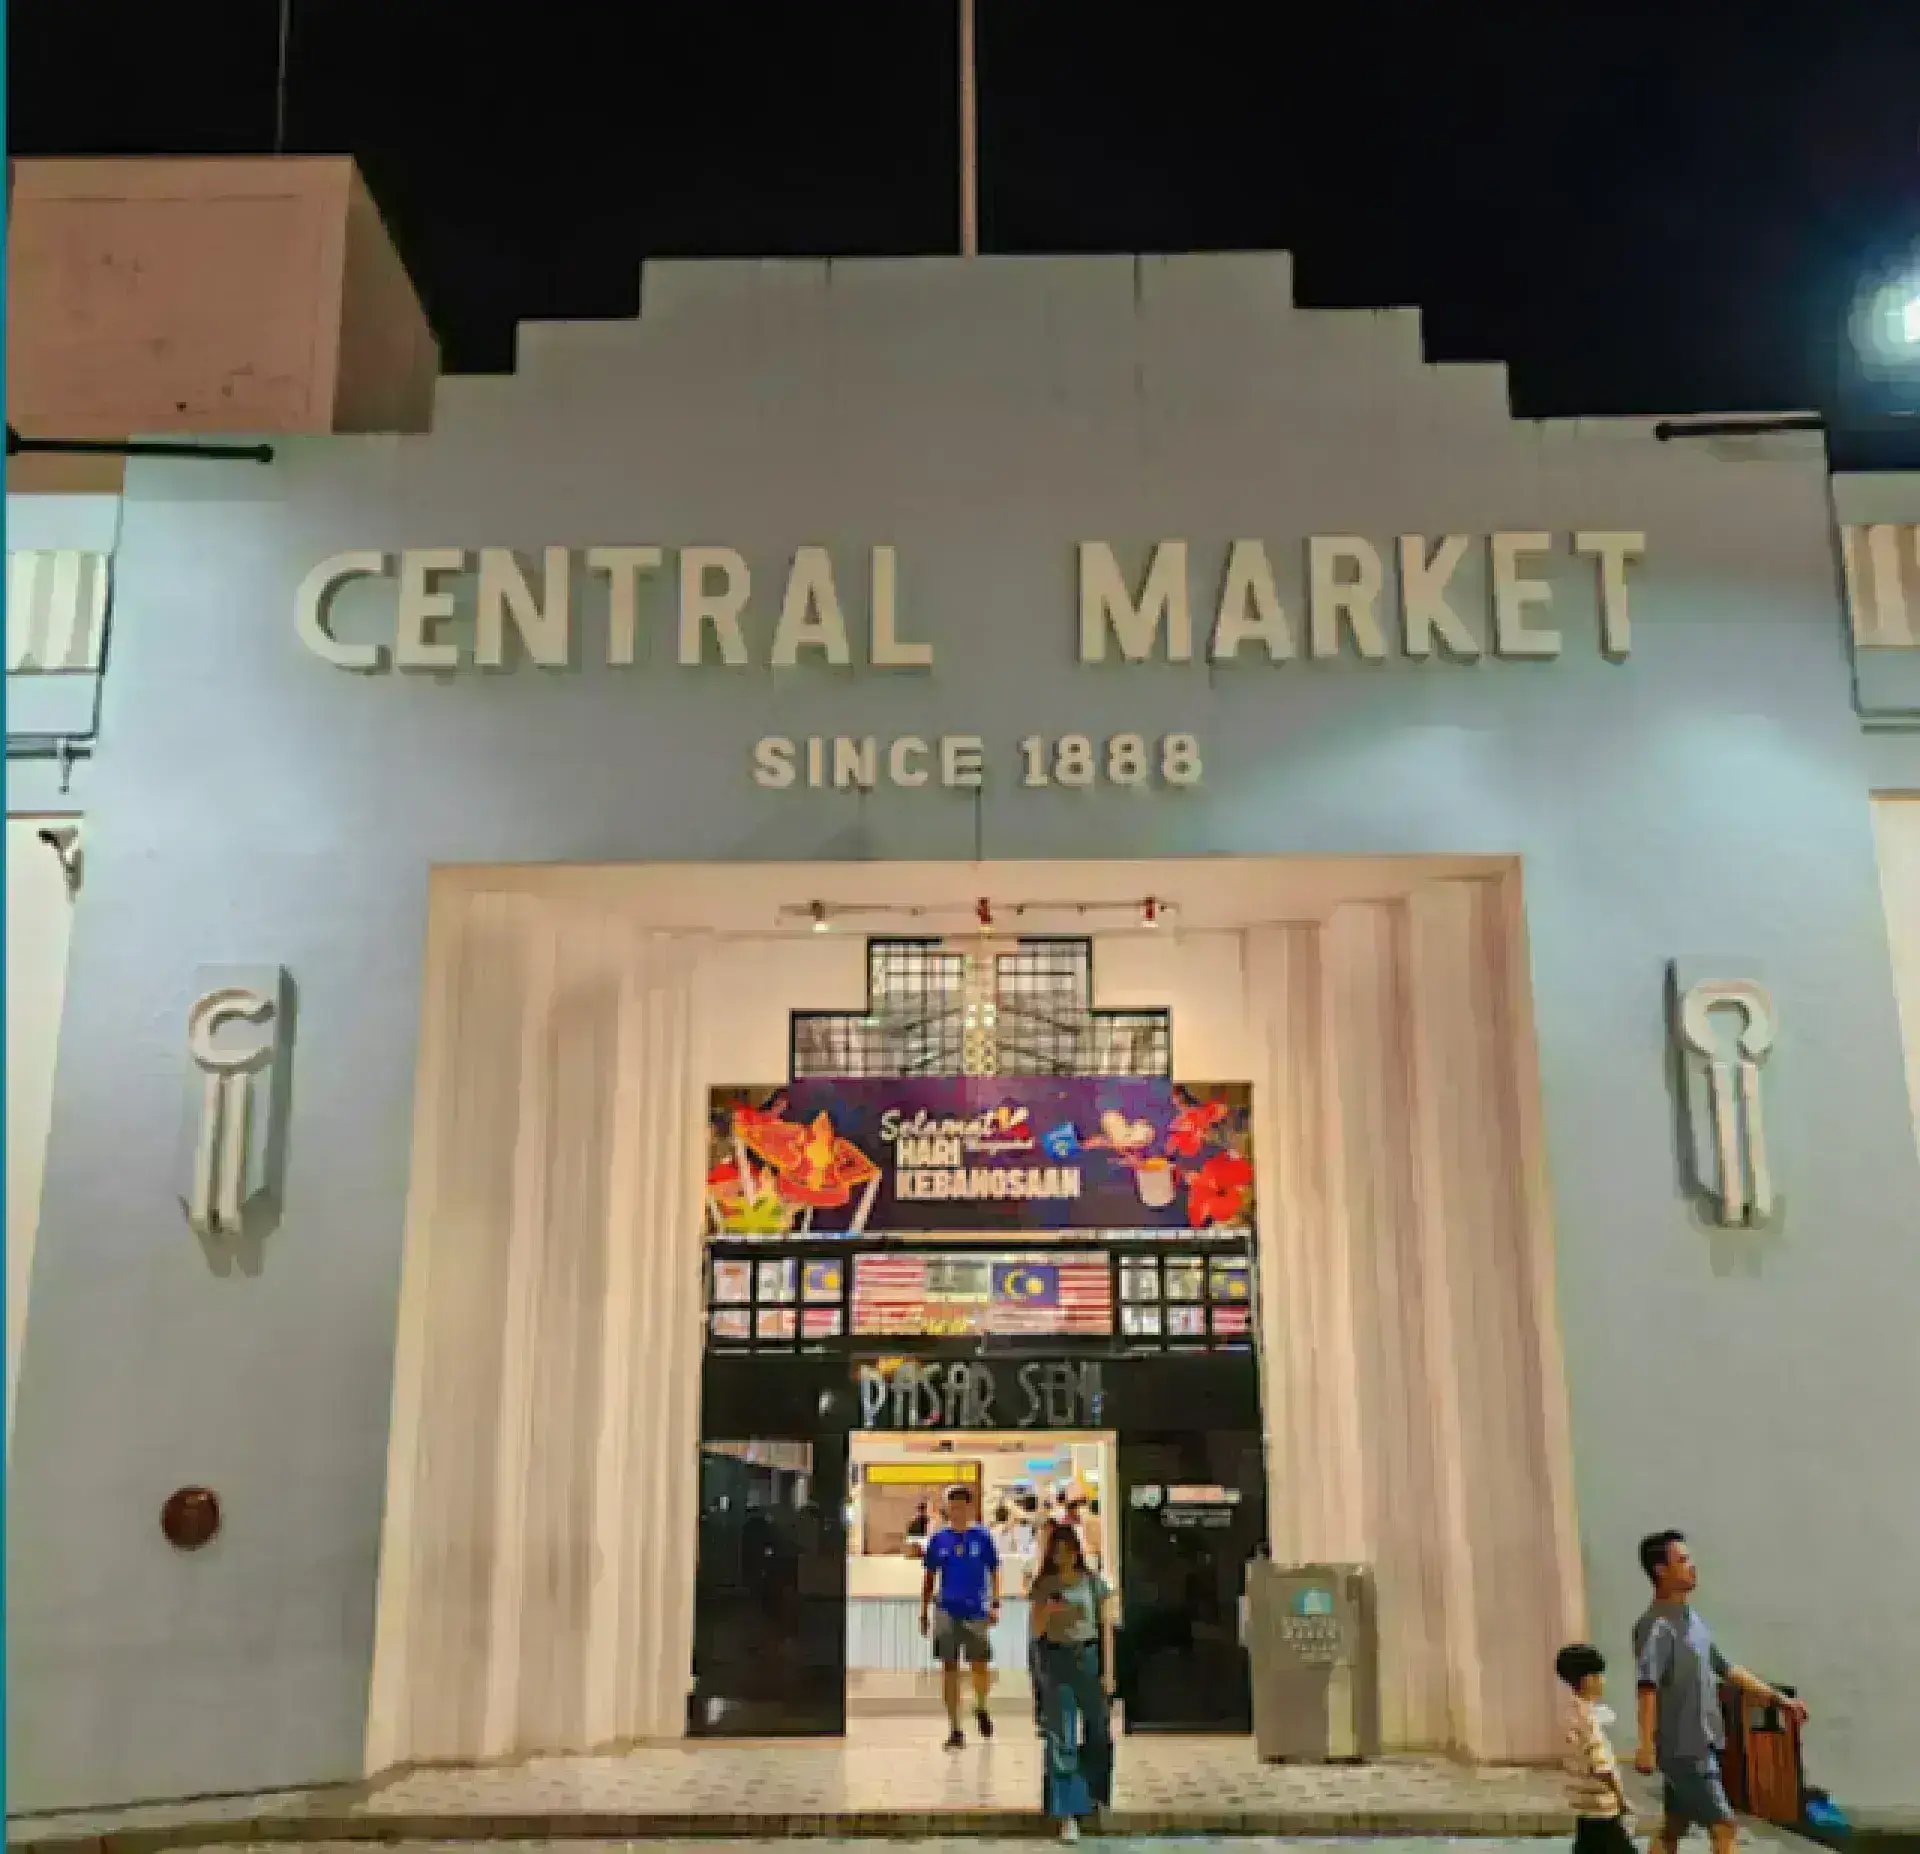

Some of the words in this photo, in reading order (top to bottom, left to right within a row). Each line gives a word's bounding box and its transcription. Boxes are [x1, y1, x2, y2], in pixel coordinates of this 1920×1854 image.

[295, 545, 932, 669] CENTRAL
[1077, 531, 1645, 663] MARKET
[754, 735, 983, 787] SINCE
[1021, 733, 1202, 787] 1888
[897, 1137, 961, 1168] HARI
[860, 1361, 996, 1427] PASAR
